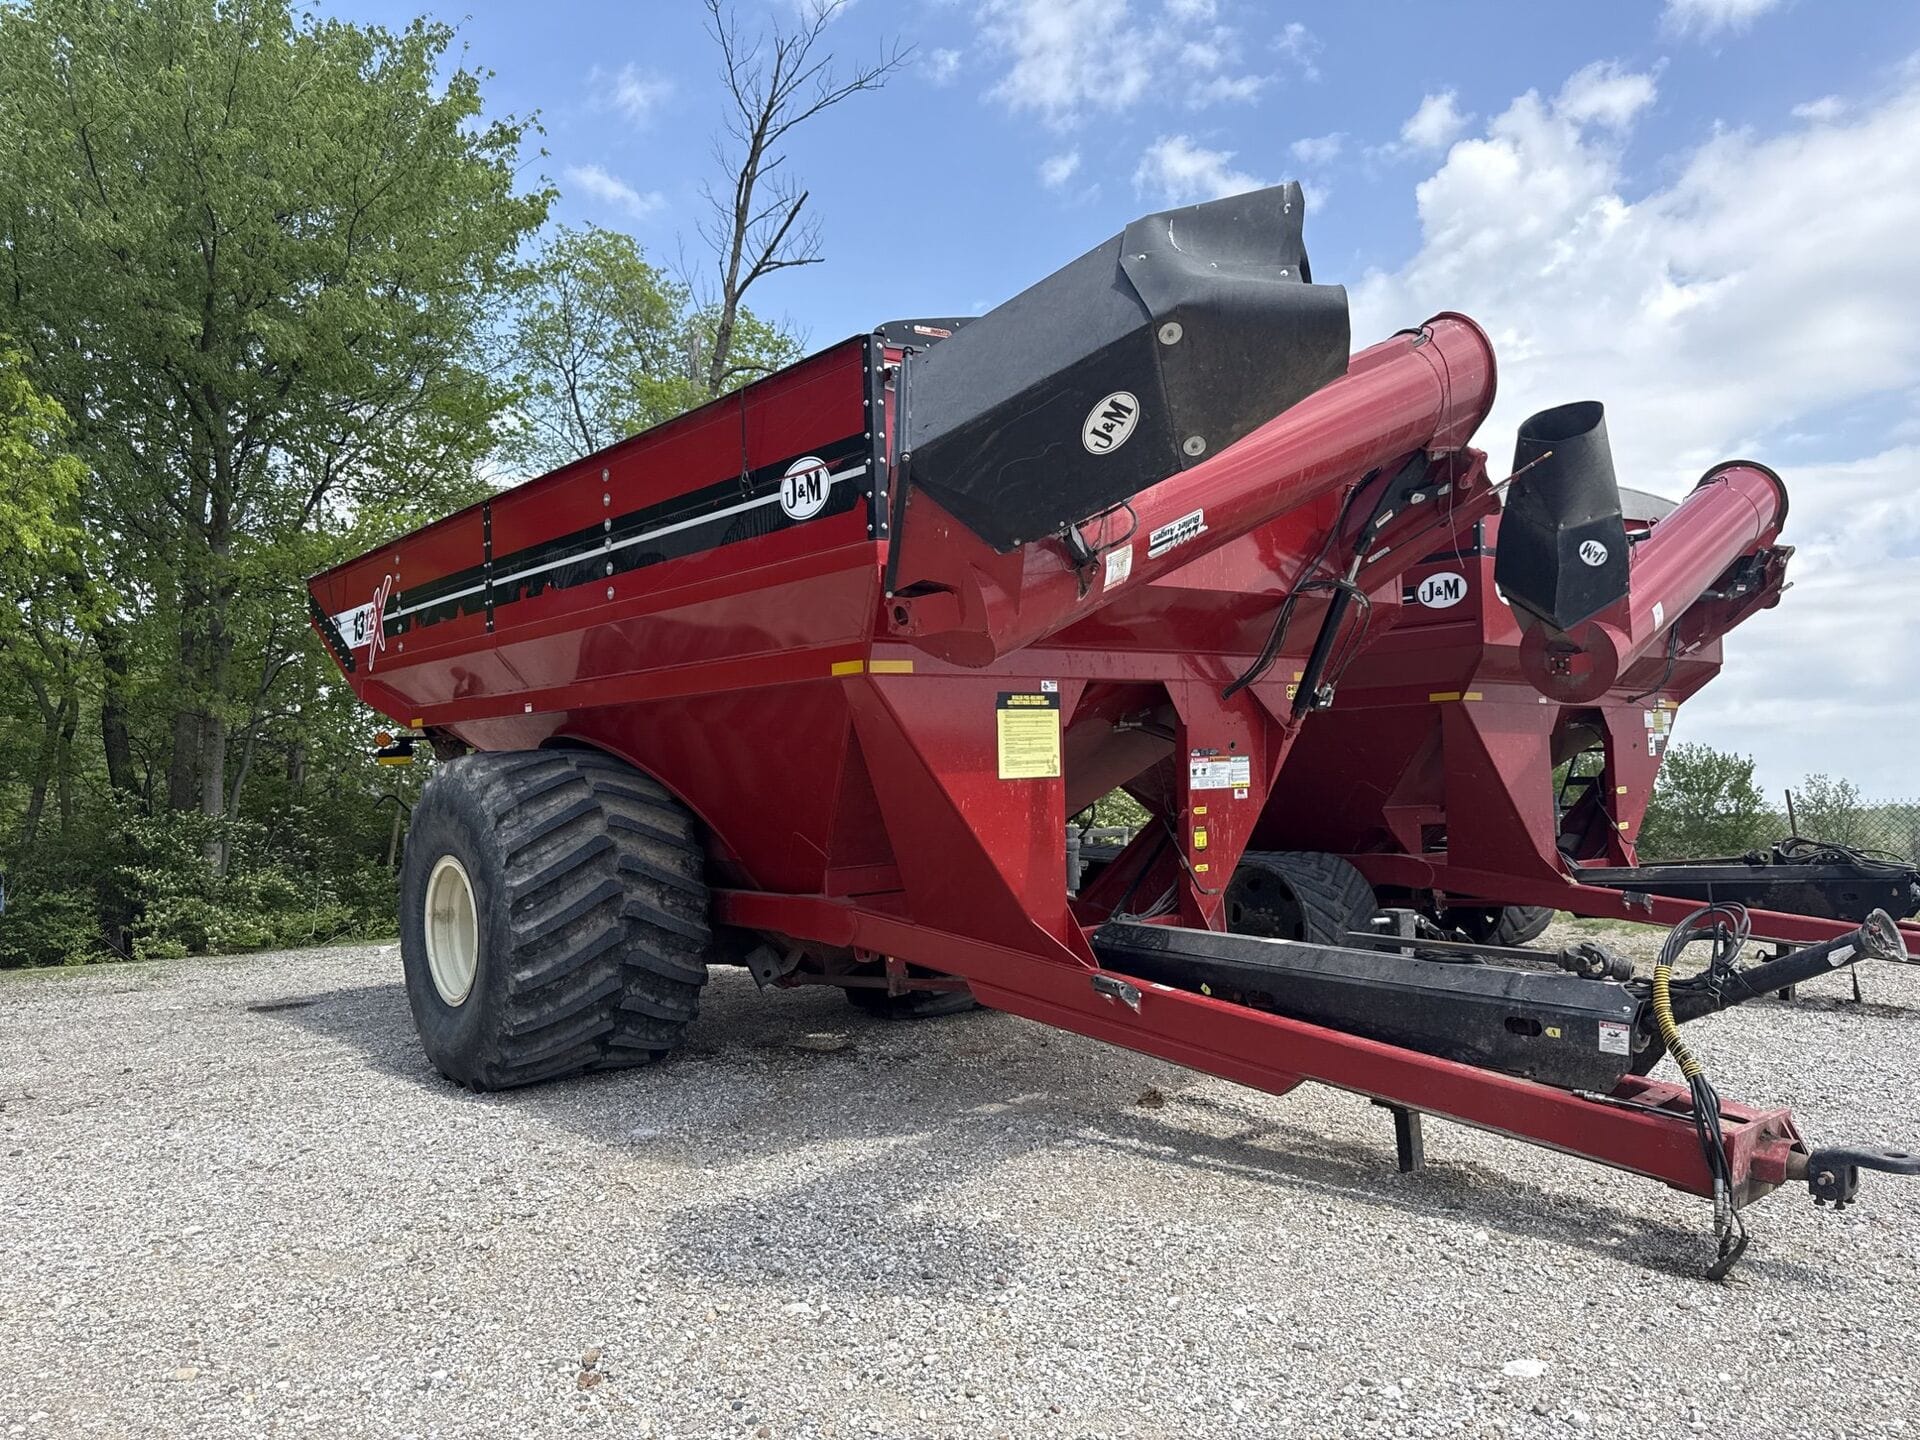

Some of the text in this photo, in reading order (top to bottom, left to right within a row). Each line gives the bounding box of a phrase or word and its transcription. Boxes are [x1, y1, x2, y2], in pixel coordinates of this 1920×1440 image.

[1091, 399, 1134, 449] J&M
[785, 470, 822, 509] J&M
[1581, 542, 1607, 563] J&M
[1421, 577, 1462, 603] J&M
